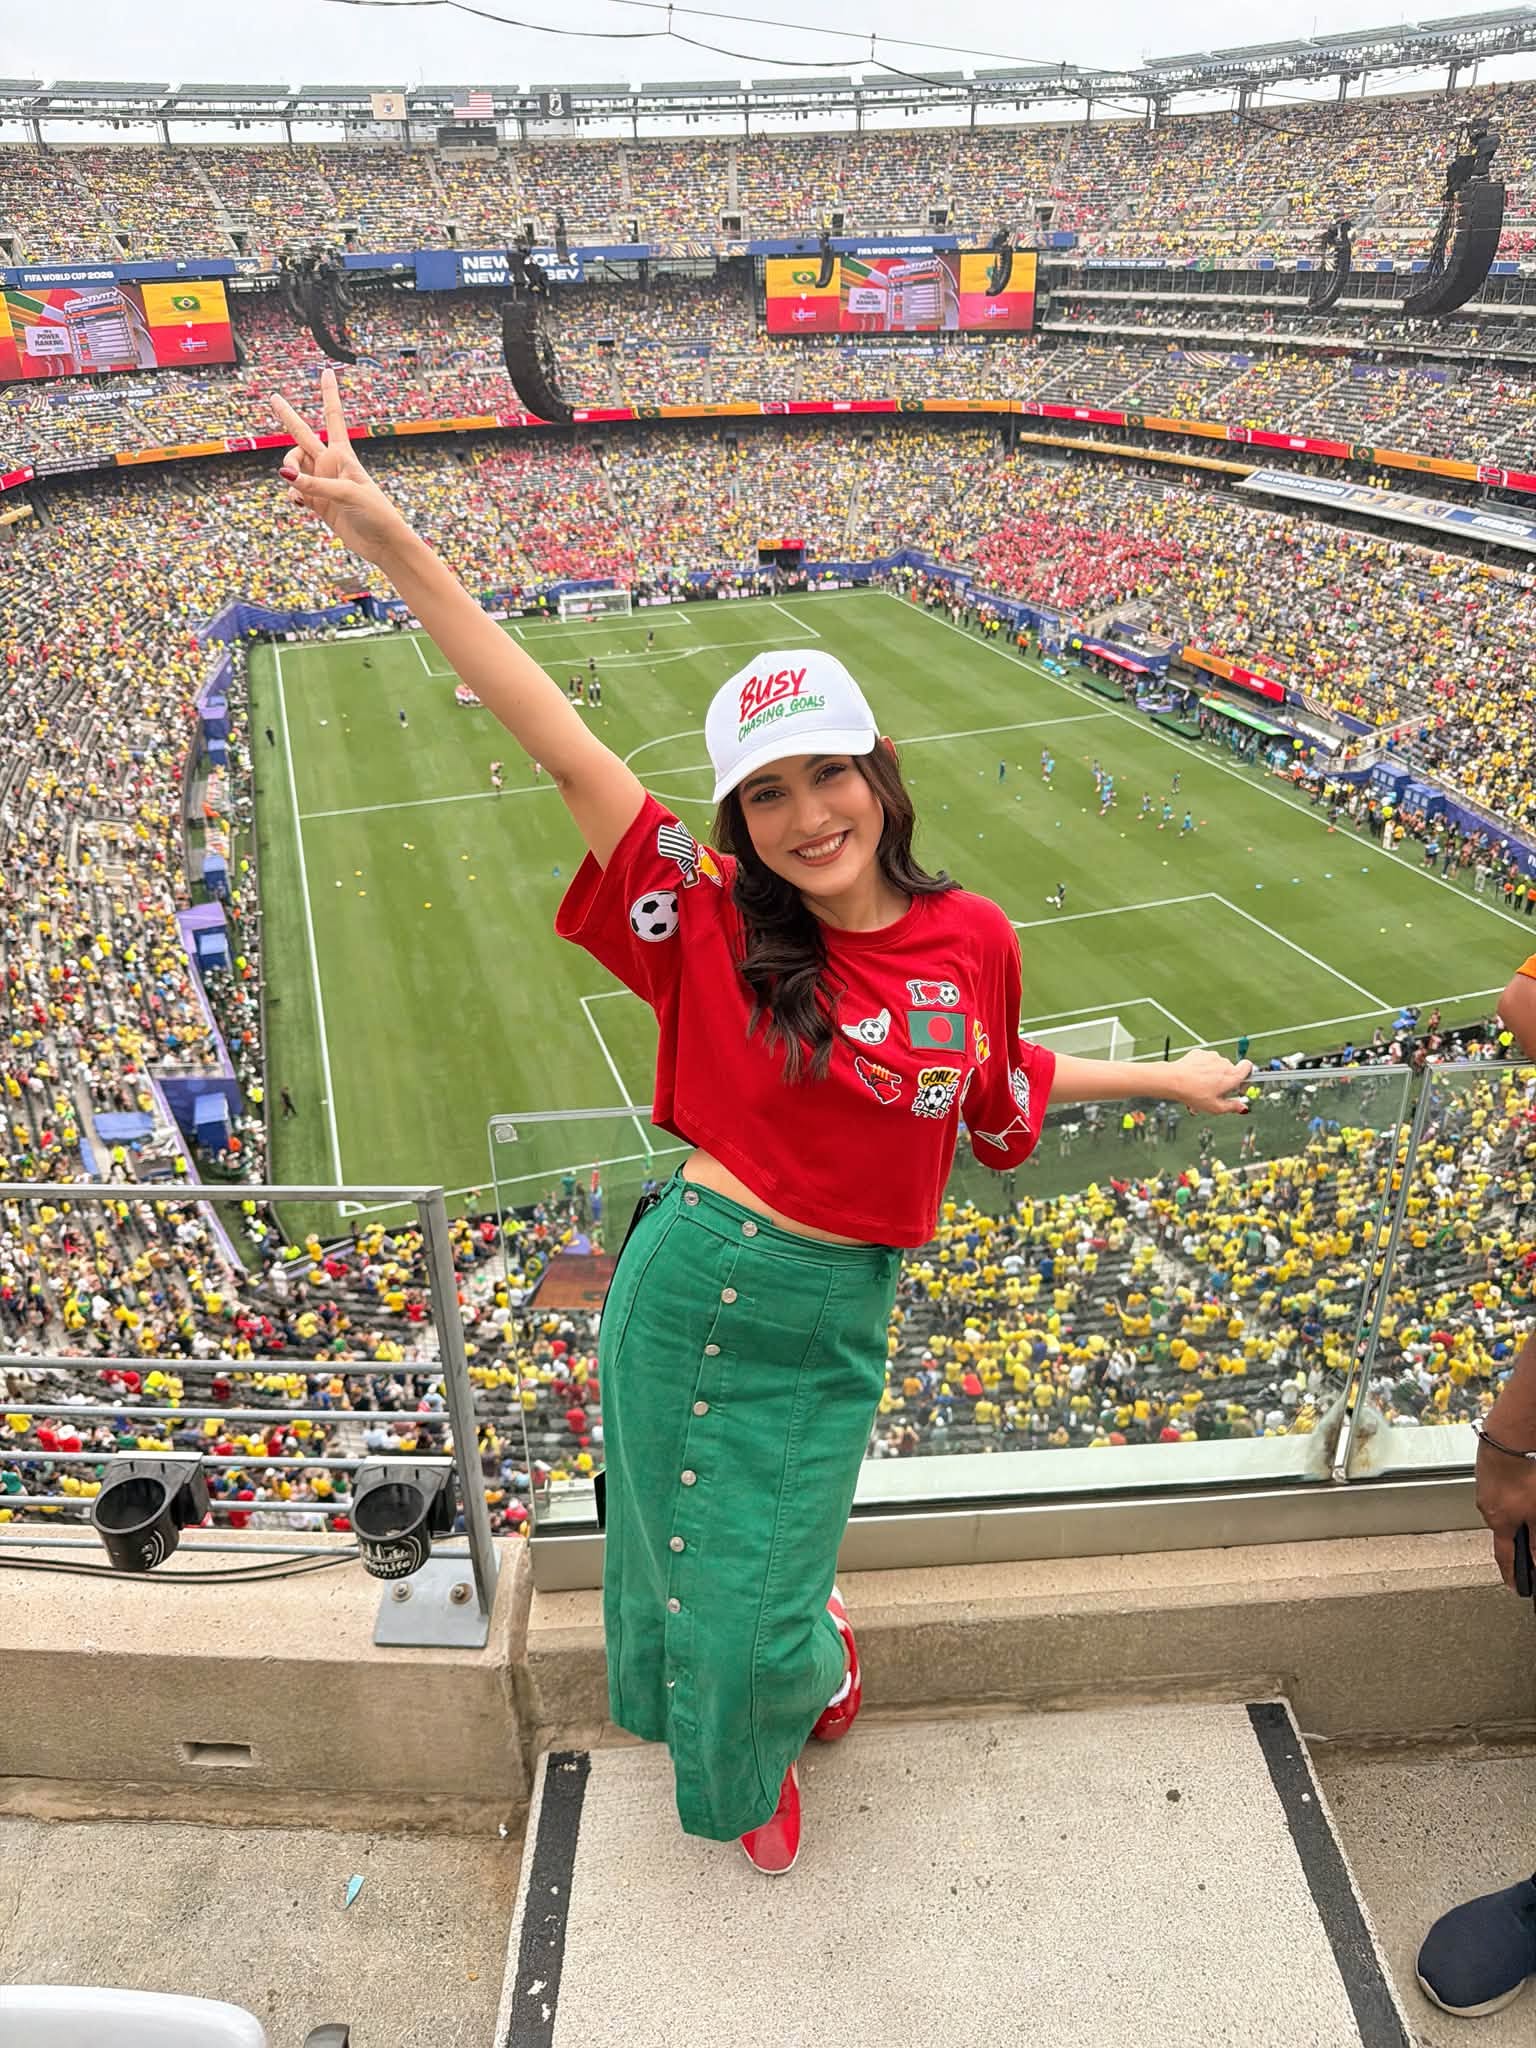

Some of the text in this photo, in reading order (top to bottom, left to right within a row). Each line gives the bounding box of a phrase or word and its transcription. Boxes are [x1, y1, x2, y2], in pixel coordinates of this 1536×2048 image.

[857, 247, 872, 255] FIFA
[896, 246, 909, 254] CUP
[462, 254, 510, 270] NEW
[23, 271, 114, 282] FIFA WORLD CUP 2026
[464, 271, 506, 284] NEW
[739, 667, 807, 723] BUSY
[738, 695, 825, 743] CHASING GOALS
